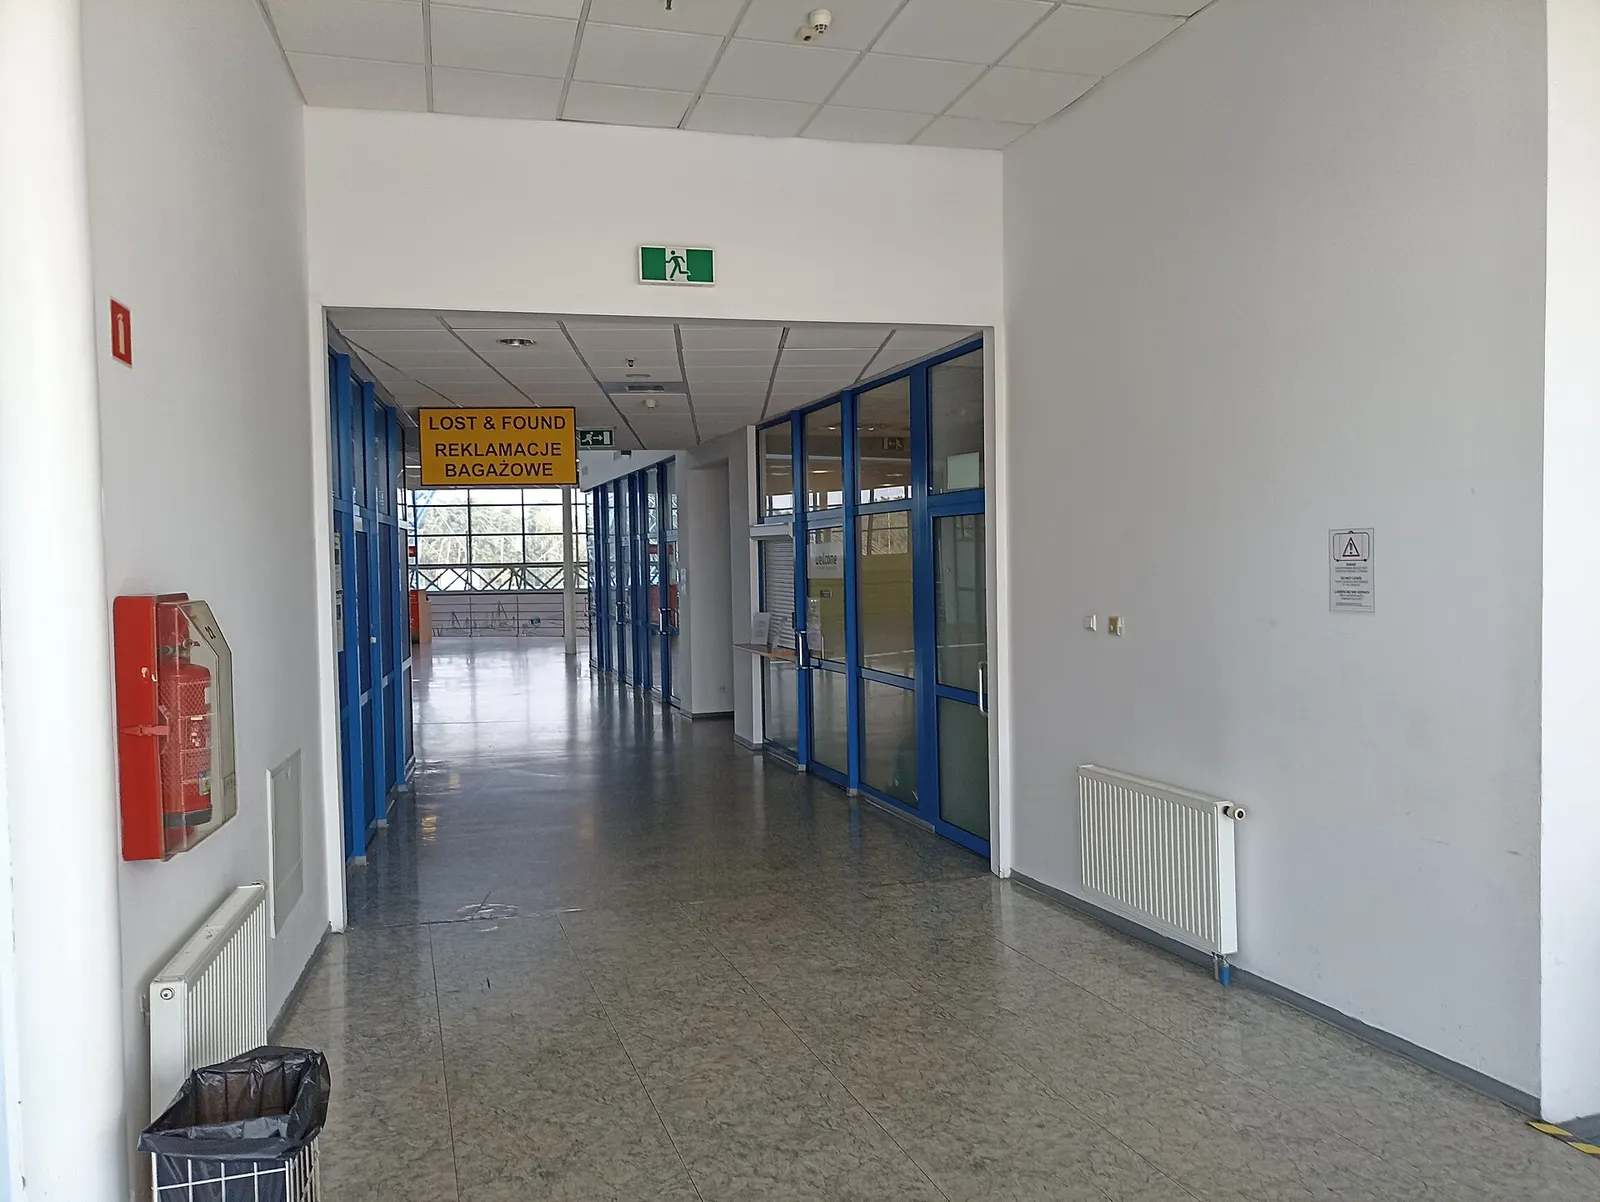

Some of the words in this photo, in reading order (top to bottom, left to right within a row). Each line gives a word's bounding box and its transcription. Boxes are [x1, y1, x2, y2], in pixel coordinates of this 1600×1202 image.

[429, 415, 477, 430] LOST
[483, 415, 496, 430] &
[502, 415, 566, 430] FOUND
[435, 442, 562, 457] REKLAMACJE
[445, 459, 553, 478] BAGAŻOWE
